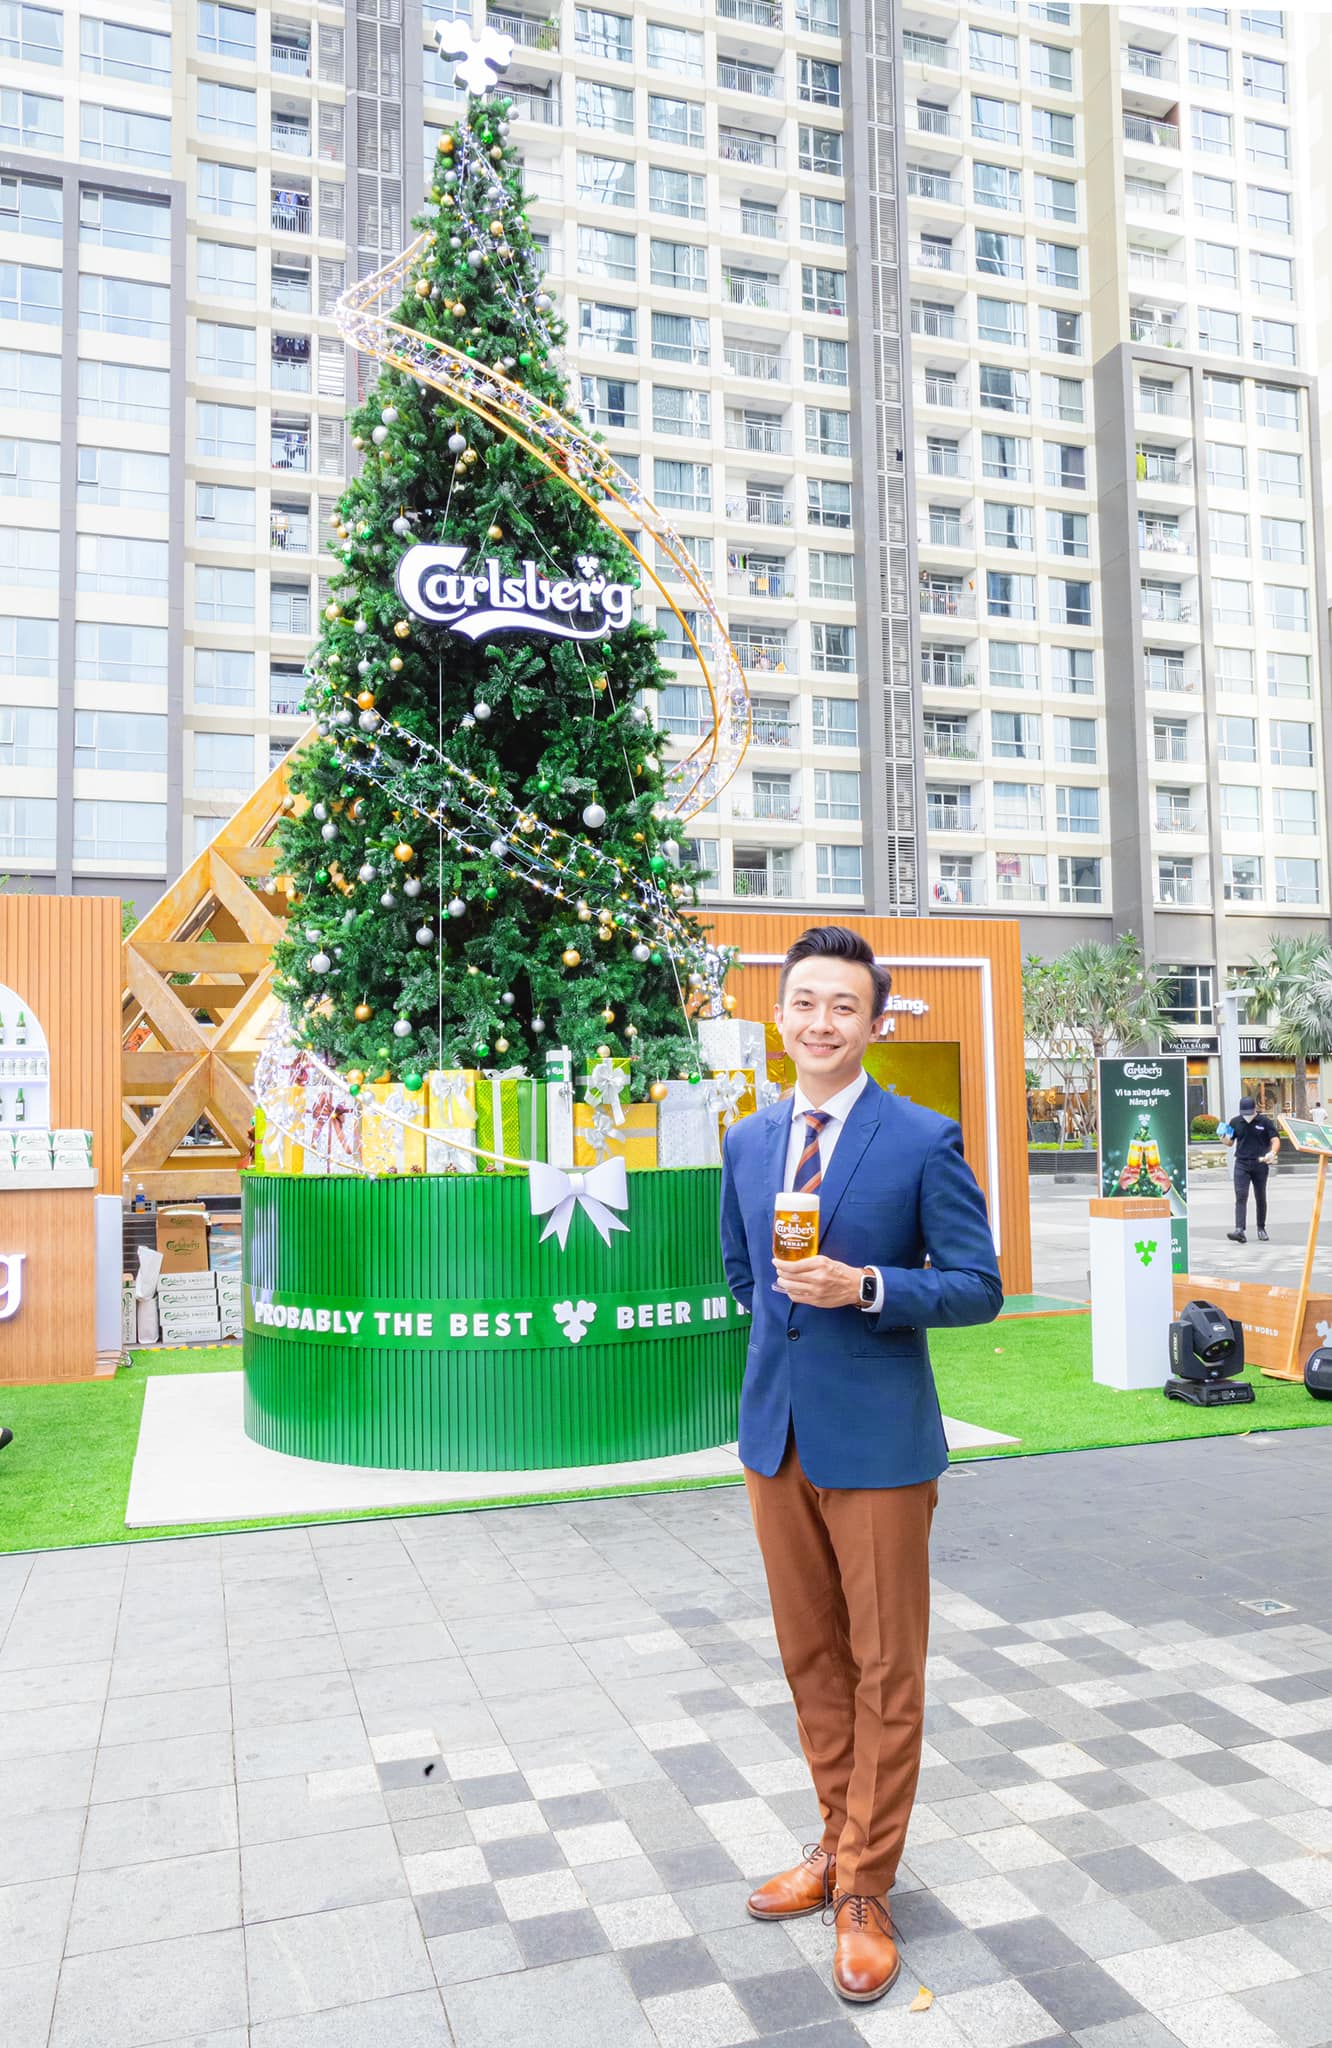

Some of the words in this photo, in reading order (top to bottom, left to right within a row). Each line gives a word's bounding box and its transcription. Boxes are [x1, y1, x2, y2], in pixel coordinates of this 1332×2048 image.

[397, 543, 634, 640] Carlsberg
[1123, 1062, 1163, 1080] Carlsberg
[774, 1219, 816, 1240] Carlsberg
[165, 1239, 200, 1252] Carlsberg
[254, 1301, 364, 1334] PROBABLY
[374, 1312, 433, 1337] THE
[449, 1311, 533, 1337] BEST
[616, 1300, 692, 1330] BEER
[703, 1296, 727, 1321] IN
[1255, 1326, 1279, 1338] WORLD
